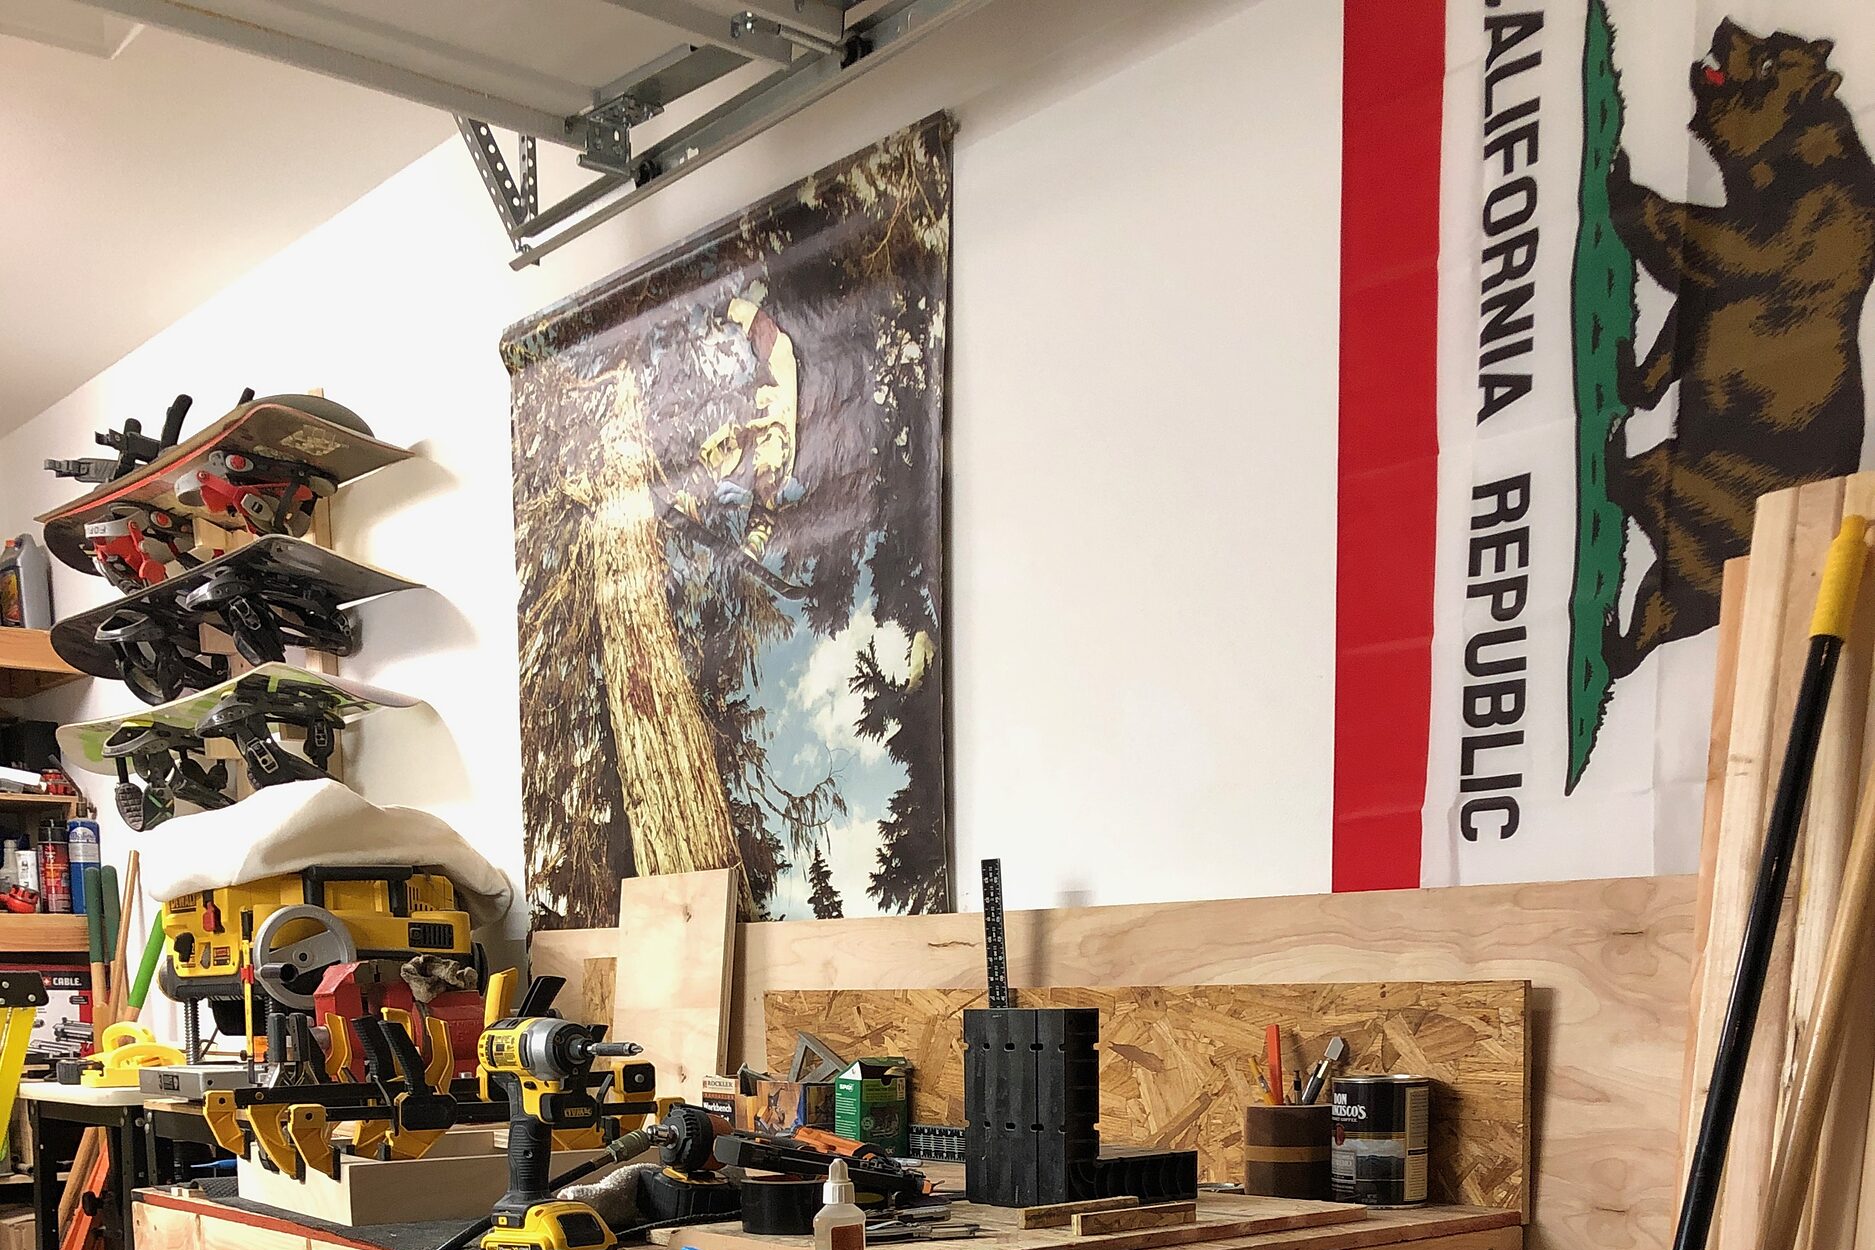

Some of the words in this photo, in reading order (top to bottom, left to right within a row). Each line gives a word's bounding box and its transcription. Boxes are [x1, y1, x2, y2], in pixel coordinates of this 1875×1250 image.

[1478, 0, 1543, 426] ALIFORNIA
[1460, 472, 1531, 842] REPUBLIC
[1331, 1105, 1367, 1120] NCISCO'S
[1333, 1093, 1348, 1105] DON
